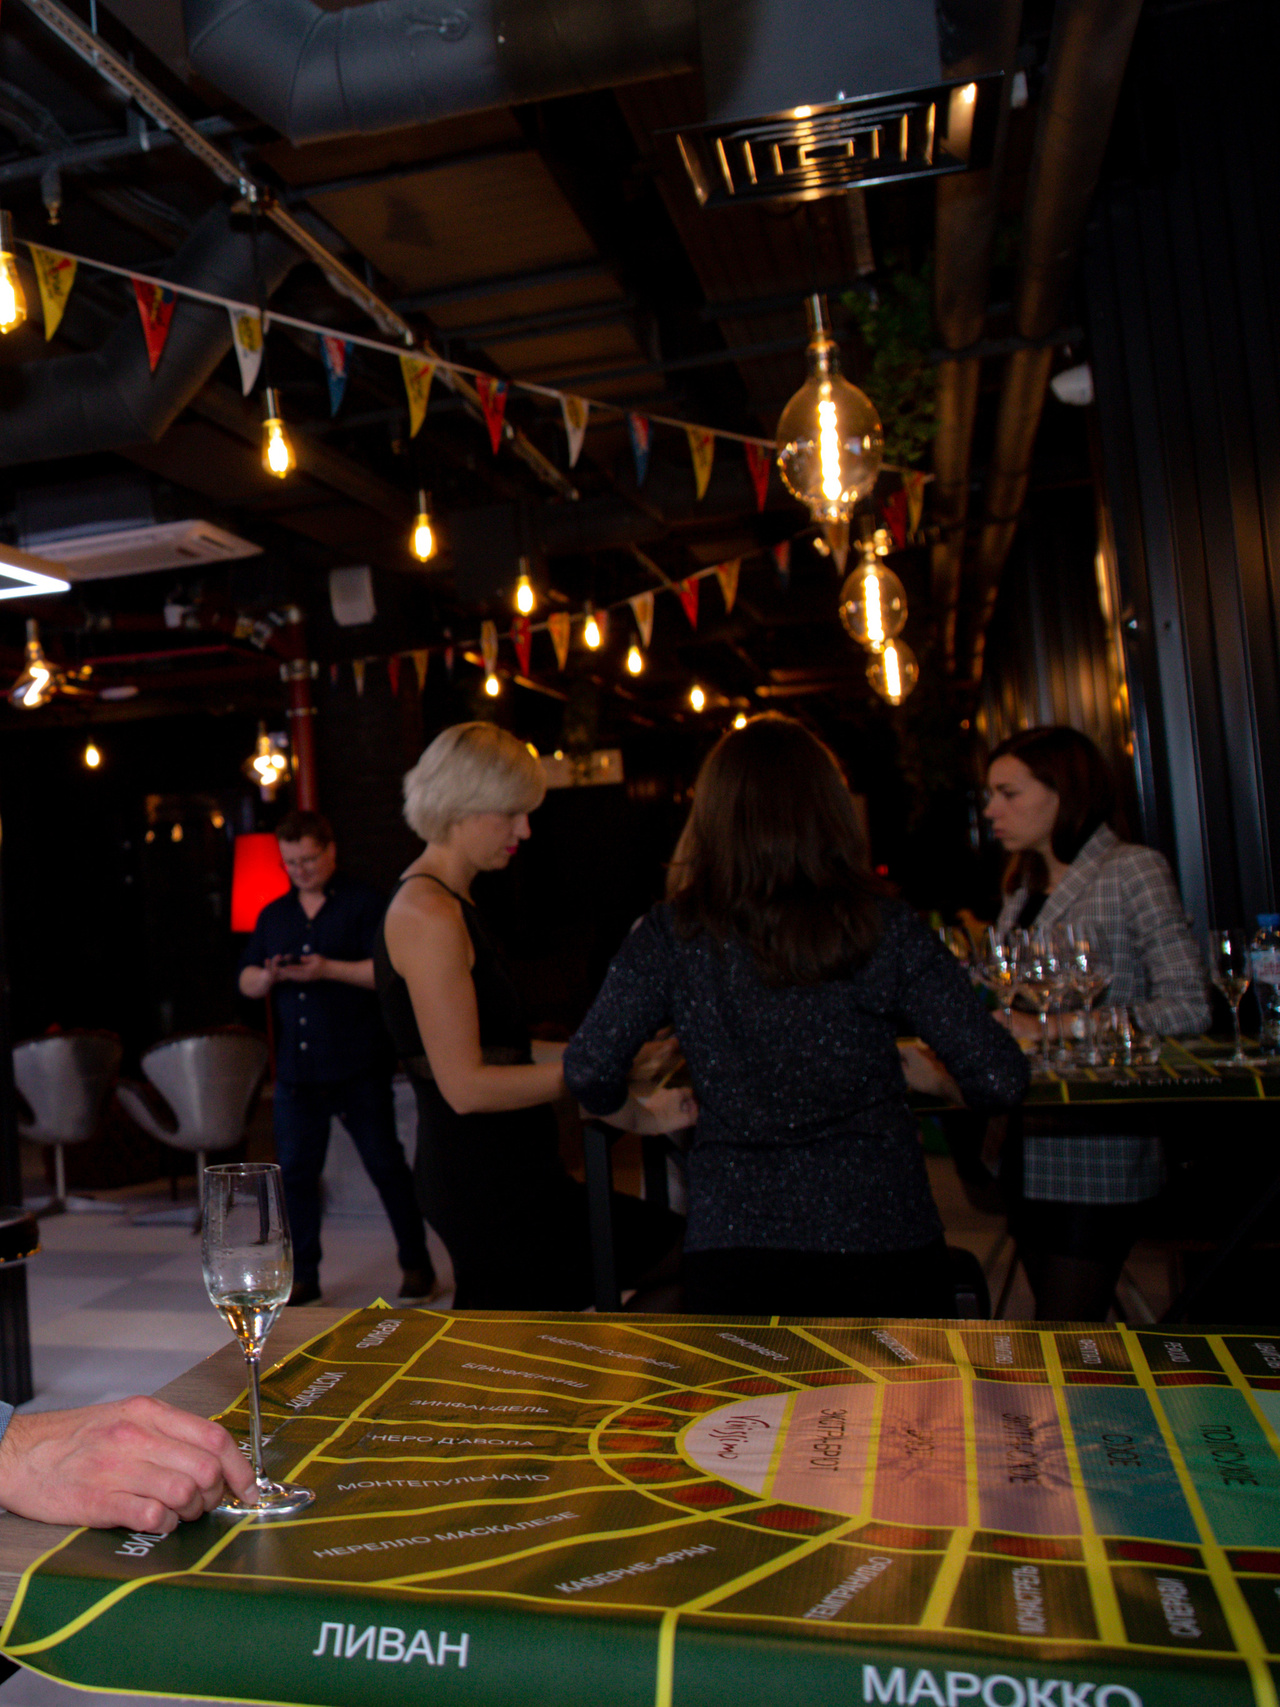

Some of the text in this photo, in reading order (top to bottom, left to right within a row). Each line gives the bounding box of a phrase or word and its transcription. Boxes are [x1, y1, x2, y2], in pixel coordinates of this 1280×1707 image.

[355, 1319, 405, 1349] ИЗРАИЛЬ
[993, 1336, 1013, 1364] ПРИМИТИВО
[1078, 1339, 1101, 1364] ФРАППАТО
[285, 1371, 348, 1408] ИСПАНИЯ
[460, 1361, 590, 1389] БЛАУФРЕНКИШ
[409, 1398, 550, 1414] ЗИНФАНДЕЛЬ
[372, 1434, 535, 1448] НЕРО Д'АВОЛА
[708, 1414, 770, 1461] Vinissimo
[809, 1408, 848, 1471] ЭКСТРА-БРЮТ
[1002, 1413, 1041, 1484] ЭКСТРА-СУХОЕ
[1102, 1434, 1141, 1467] СУХОЕ
[336, 1473, 551, 1492] МОНТЕПУЛЬЧАНО
[313, 1510, 580, 1558] НЕРЕЛЛО МАСКАЛЕЗЕ
[554, 1543, 717, 1595] КАБЕРНЕ-ФРАН
[804, 1556, 893, 1620] ТЕМПРАНИЛЬО
[1012, 1565, 1047, 1634] МОНАСТРЕЛЬ
[1156, 1577, 1202, 1638] САПЕРАВИ
[312, 1621, 470, 1668] ЛИВАН
[861, 1664, 1143, 1707] МАРОККО
